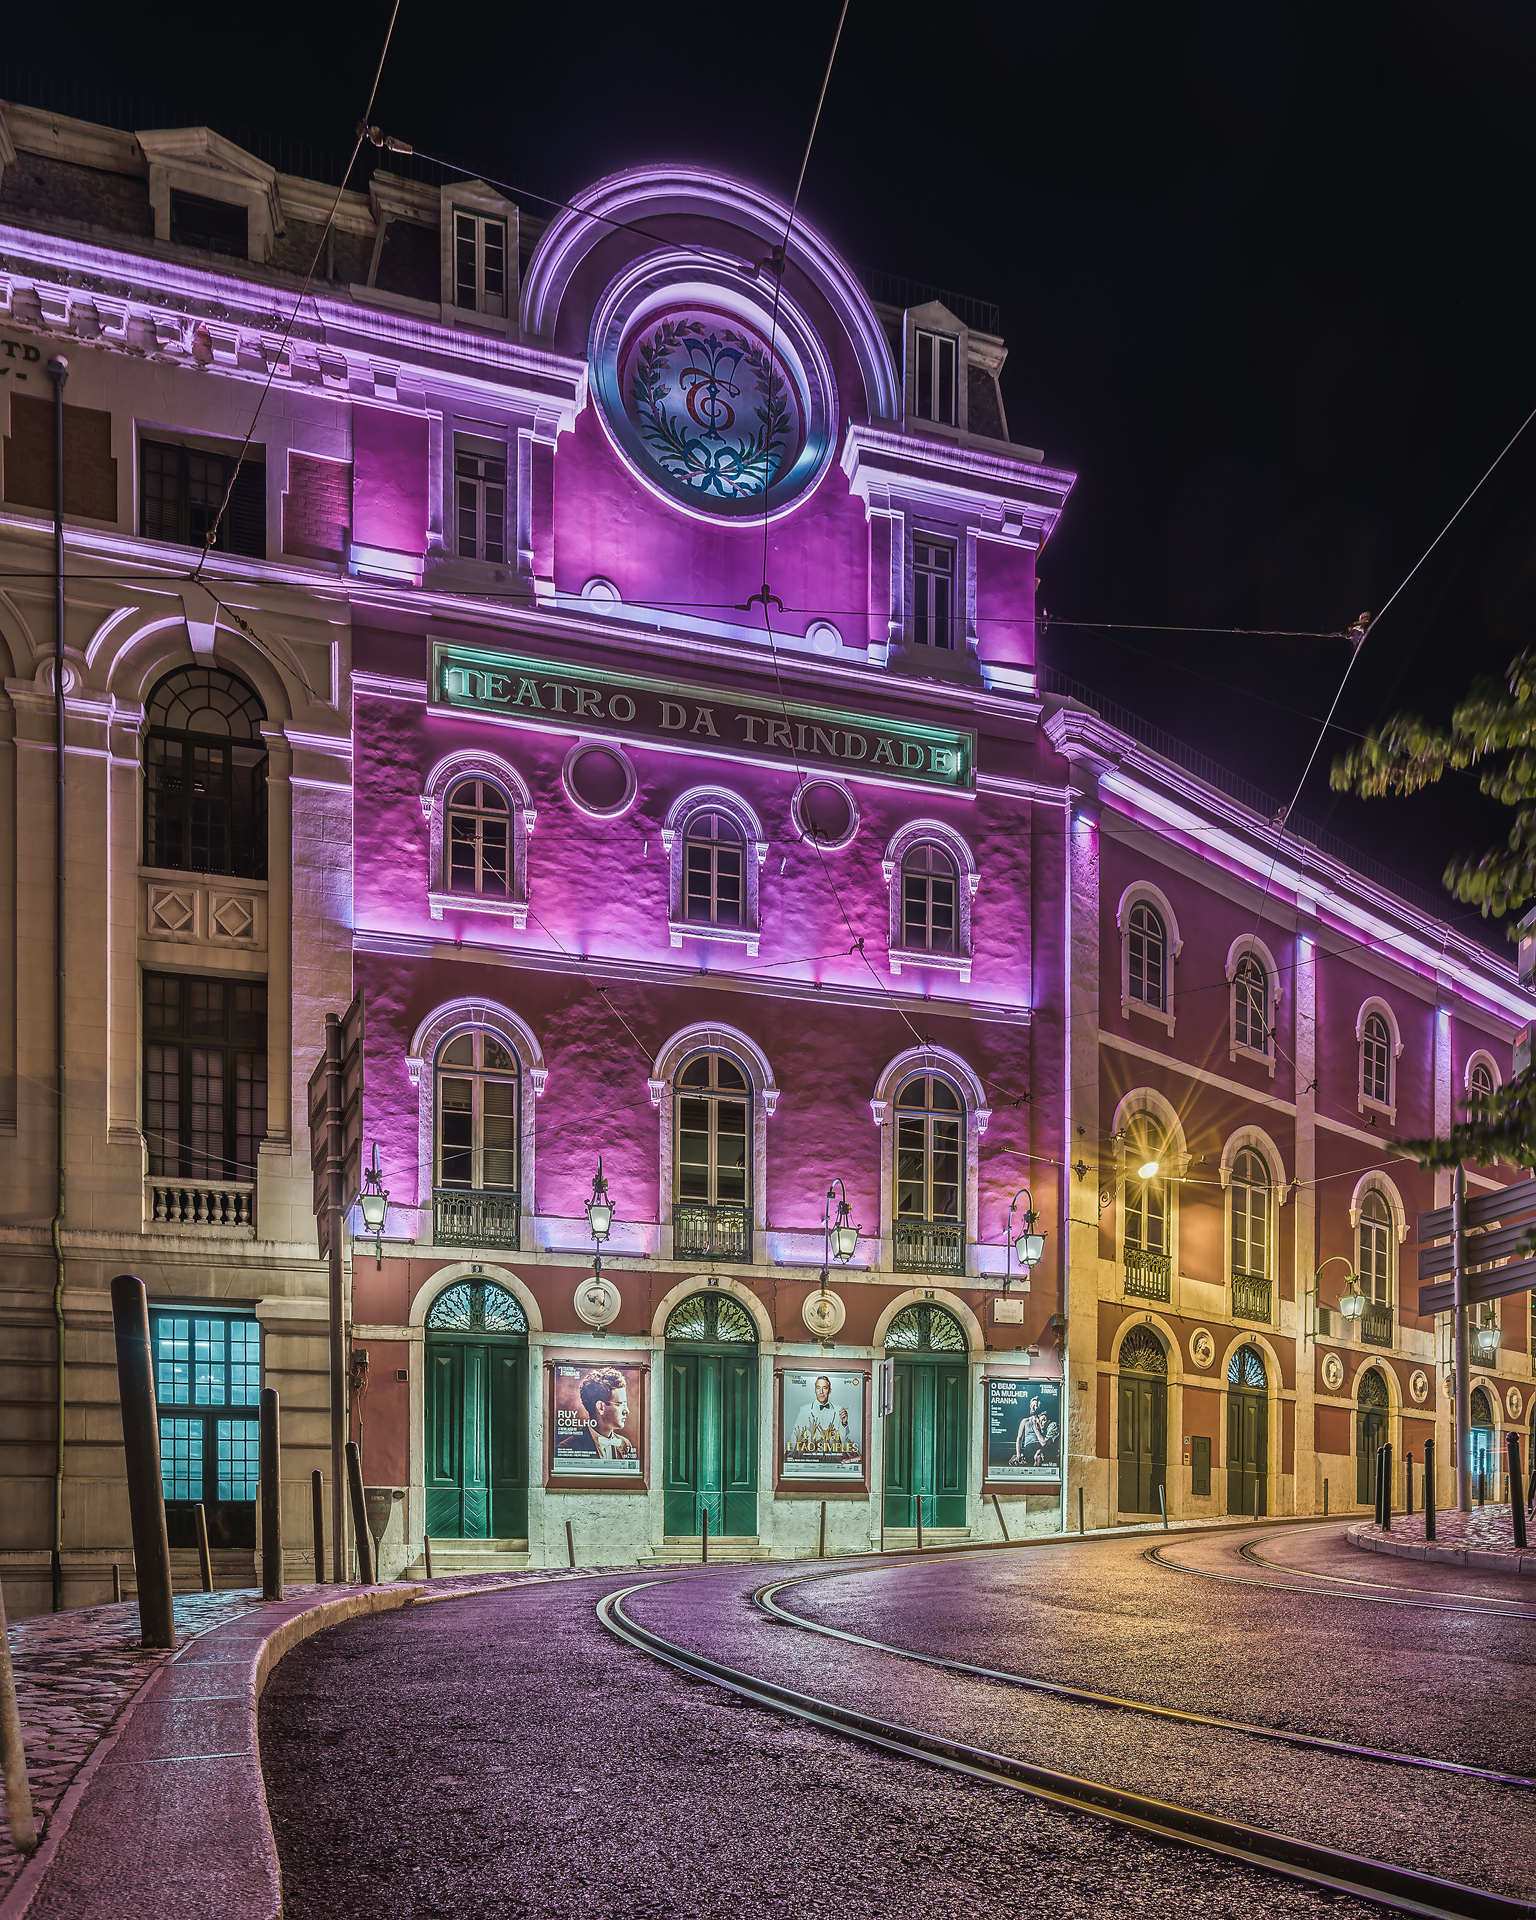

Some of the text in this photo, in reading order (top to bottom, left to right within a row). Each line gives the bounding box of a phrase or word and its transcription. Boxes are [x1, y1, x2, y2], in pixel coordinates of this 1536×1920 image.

[447, 665, 956, 776] TEATRO DA TRINDADE
[991, 1397, 1018, 1405] ARANHA
[558, 1410, 578, 1419] RUY
[558, 1419, 598, 1428] COELHO
[803, 1430, 843, 1441] O AMOR
[817, 1442, 859, 1453] SIMPLES
